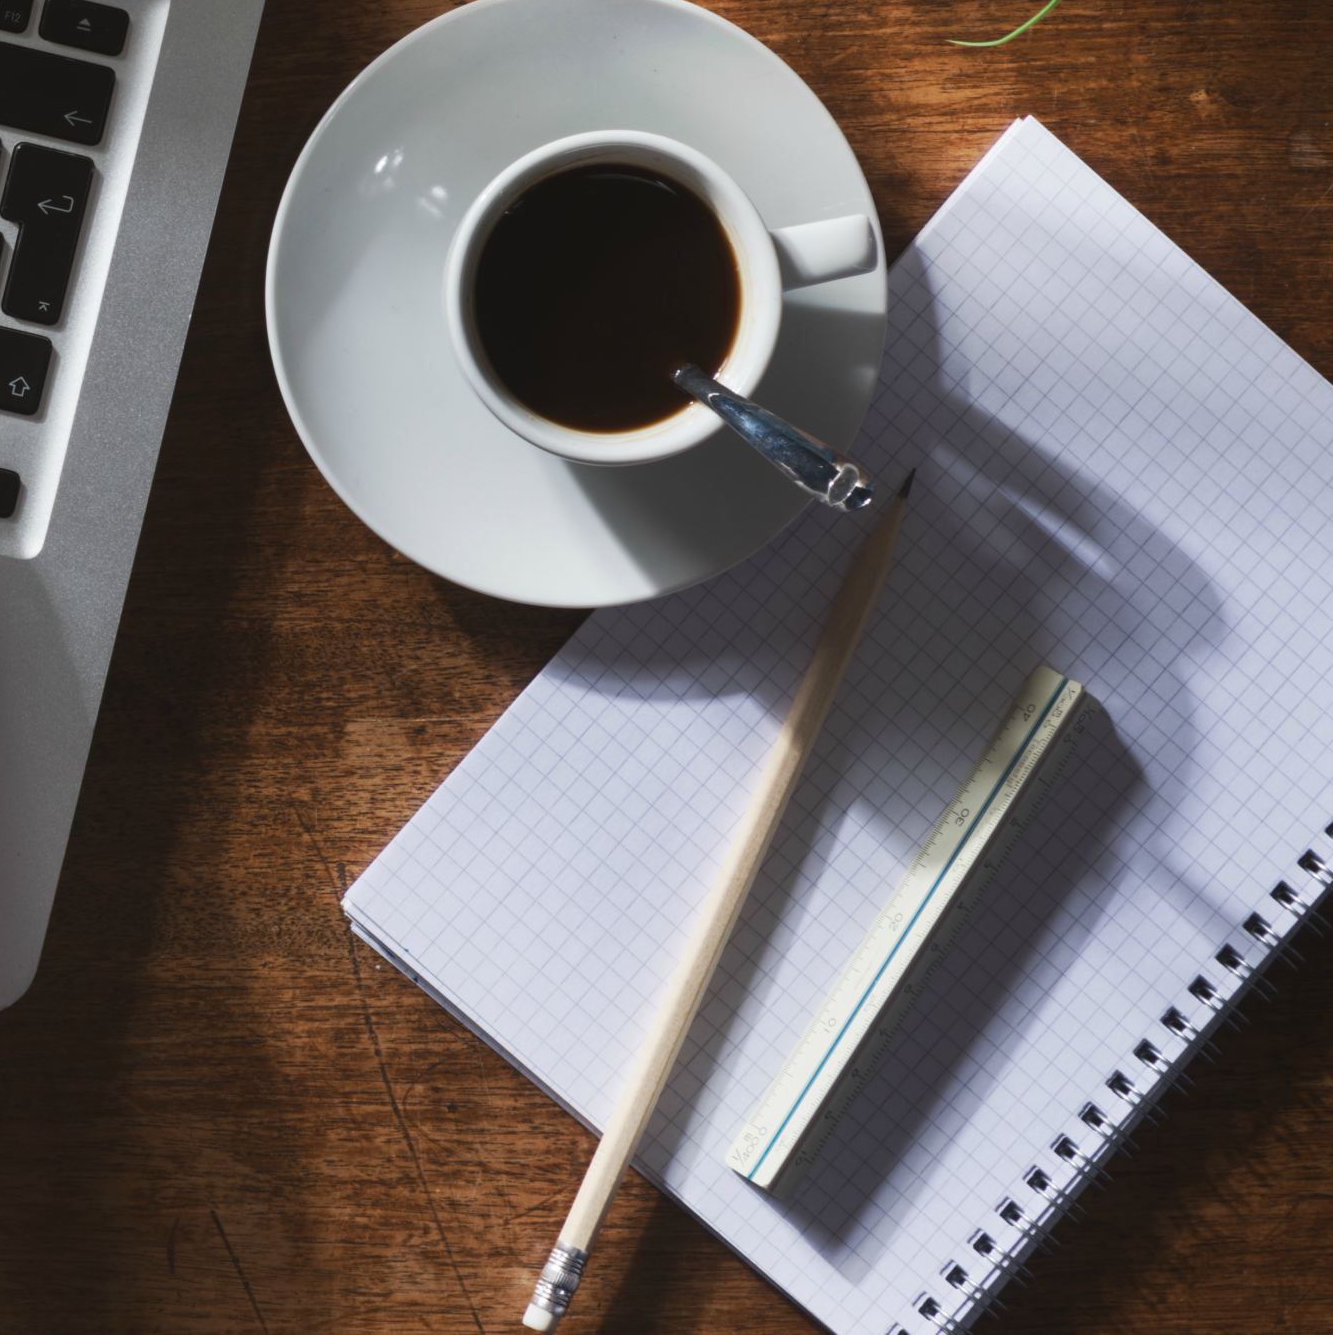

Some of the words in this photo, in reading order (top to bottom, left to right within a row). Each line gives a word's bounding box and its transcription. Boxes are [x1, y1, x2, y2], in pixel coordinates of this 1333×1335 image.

[4, 10, 22, 23] F12
[1023, 703, 1037, 722] 40
[955, 808, 970, 826] 30
[889, 912, 903, 931] 20
[824, 1017, 837, 1033] 10
